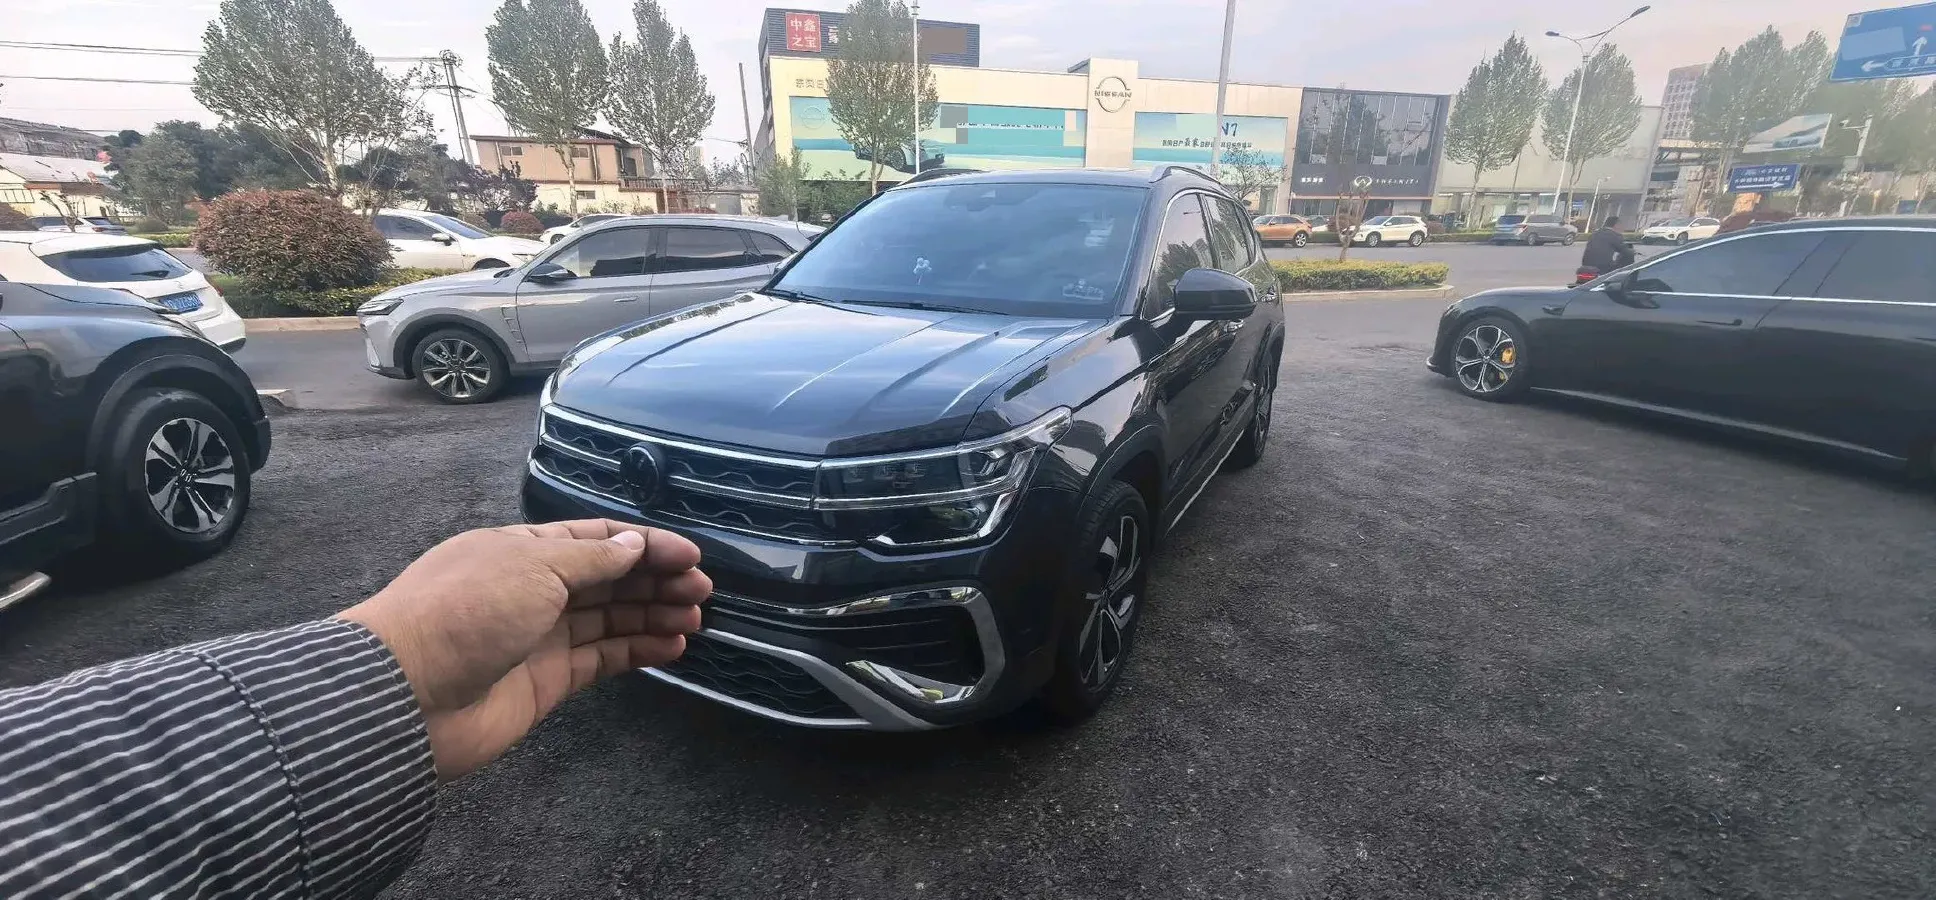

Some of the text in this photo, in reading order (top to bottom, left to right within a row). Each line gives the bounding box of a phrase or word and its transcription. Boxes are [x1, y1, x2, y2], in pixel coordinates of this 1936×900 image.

[790, 17, 817, 32] 中鑫
[792, 35, 817, 48] 之宝
[1095, 90, 1132, 98] NISSAN
